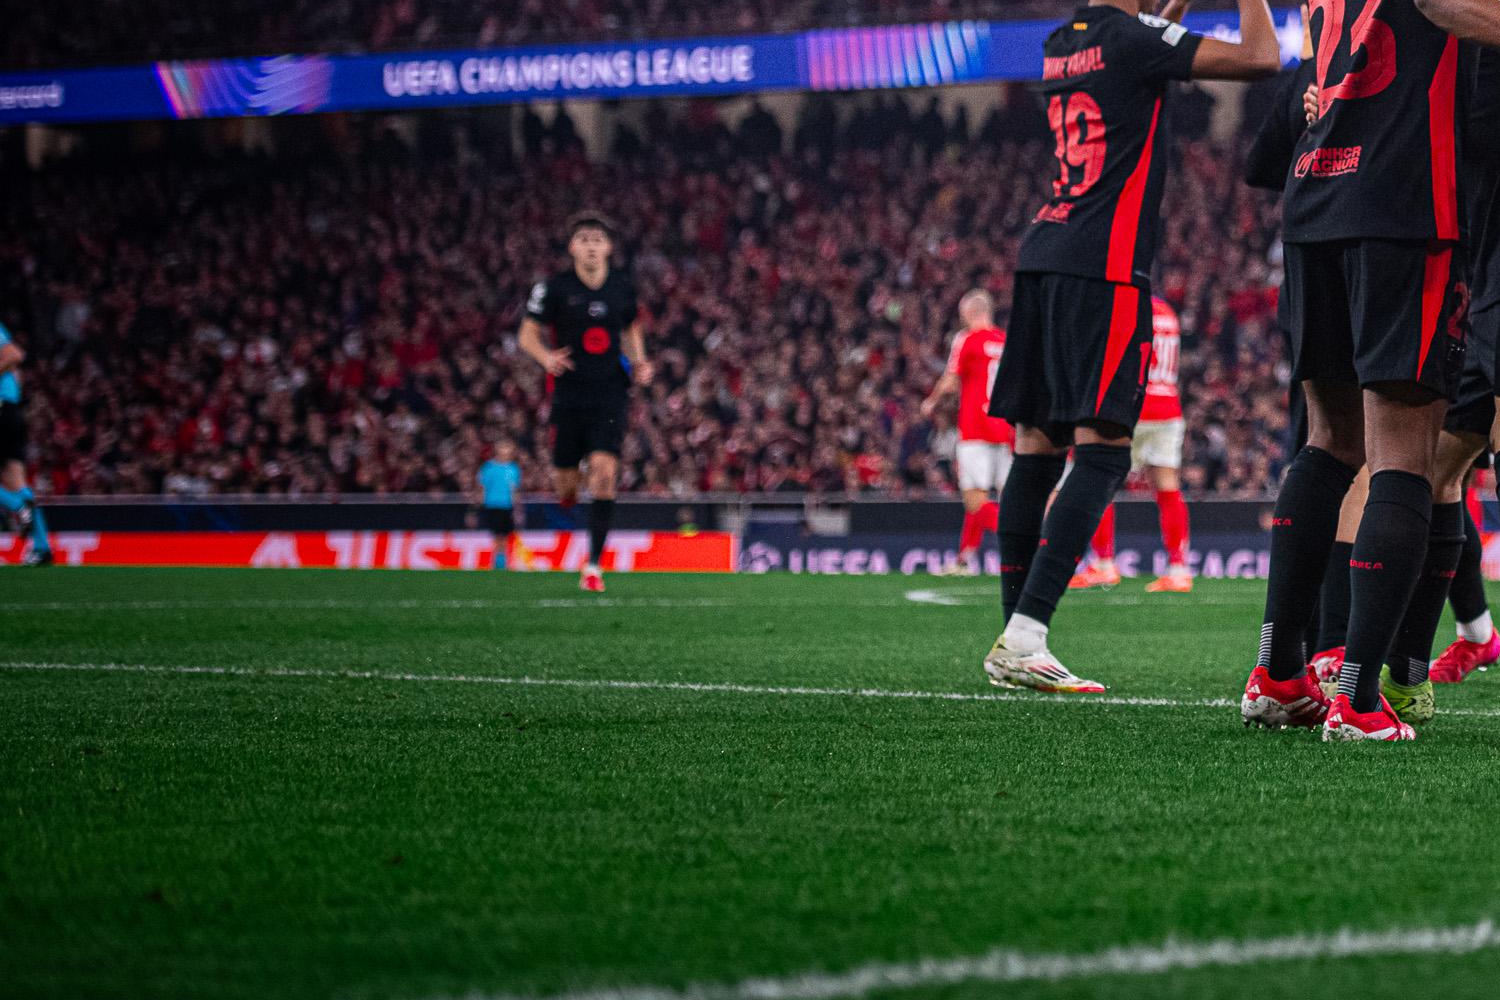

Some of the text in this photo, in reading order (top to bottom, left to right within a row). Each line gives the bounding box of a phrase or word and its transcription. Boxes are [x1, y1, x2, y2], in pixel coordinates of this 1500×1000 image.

[383, 45, 754, 98] UEFA CHAMPIONS LEAGUE
[1047, 90, 1107, 197] 19
[1313, 145, 1362, 160] UNHCR
[1311, 157, 1359, 173] ACNUR
